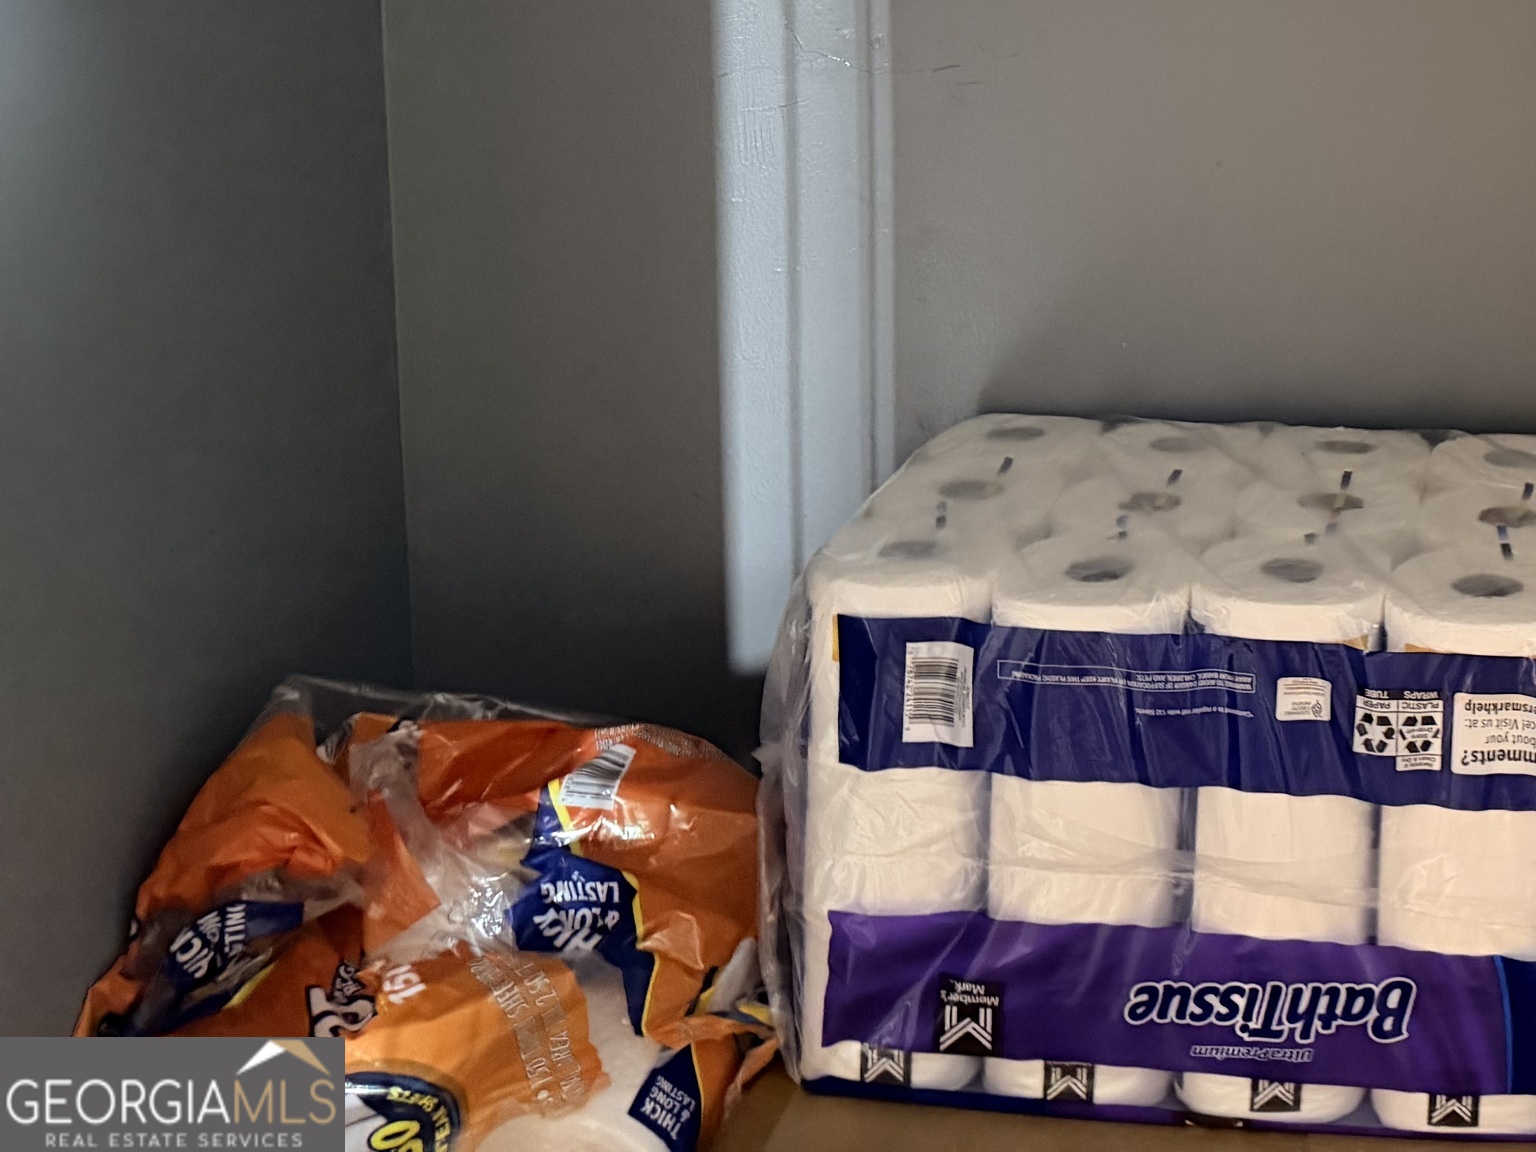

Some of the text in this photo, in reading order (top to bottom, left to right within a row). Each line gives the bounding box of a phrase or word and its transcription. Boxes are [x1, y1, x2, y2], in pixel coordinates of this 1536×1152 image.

[1364, 688, 1390, 699] TUBE
[1403, 690, 1439, 700] WRAPS
[1363, 699, 1391, 709] PAPER
[1401, 701, 1440, 710] PLASTIC
[1464, 718, 1478, 728] at:
[1481, 719, 1493, 728] us
[1494, 717, 1519, 730] Visit
[1485, 734, 1509, 745] your
[541, 879, 620, 904] LASTING
[954, 980, 986, 996] Mark
[940, 989, 1000, 1007] Member's
[655, 1075, 696, 1112] LASTING
[649, 1086, 682, 1114] LONG
[640, 1097, 682, 1140] THICK
